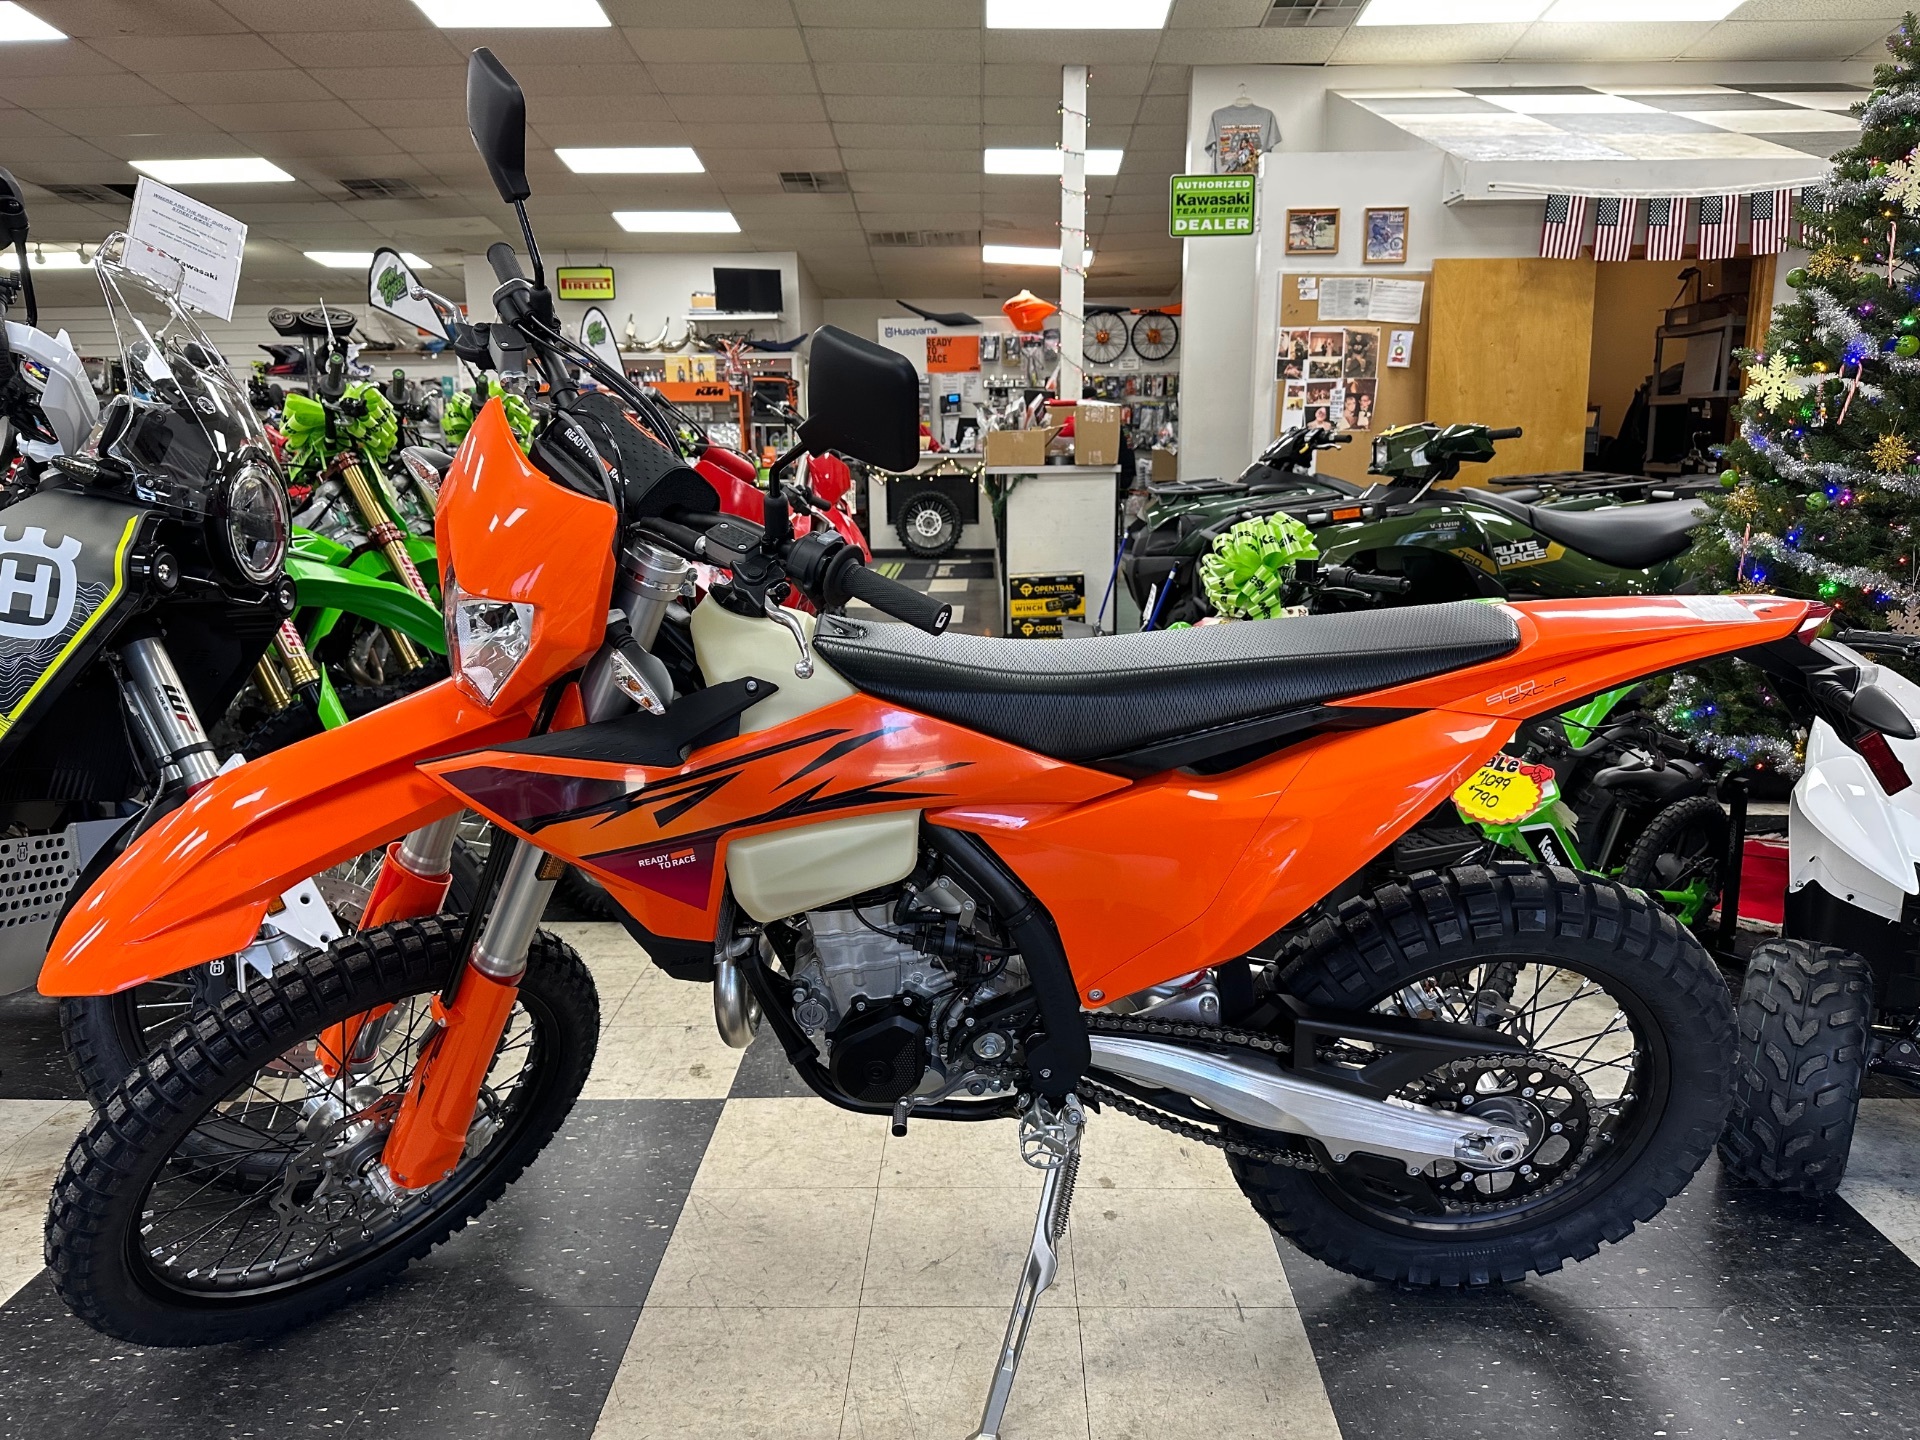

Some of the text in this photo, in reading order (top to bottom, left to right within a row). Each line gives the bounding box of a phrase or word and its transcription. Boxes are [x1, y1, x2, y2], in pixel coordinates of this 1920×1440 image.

[1176, 180, 1250, 190] AUTHORIZED
[1176, 192, 1250, 206] Kawasaki
[1176, 206, 1249, 215] TEAM GREEN
[1175, 218, 1249, 231] DEALER
[173, 257, 218, 281] Kawasaki
[561, 278, 611, 290] PIRELLI
[894, 327, 937, 337] Husqvarna
[926, 338, 952, 347] READY
[927, 355, 948, 364] RACE
[695, 386, 724, 396] KTM
[564, 427, 586, 451] READY
[1430, 520, 1460, 529] V-TWIN
[1458, 549, 1483, 566] 750
[1486, 680, 1536, 706] 500
[1508, 677, 1567, 704] EXC-F
[1468, 784, 1500, 808] $790
[638, 853, 669, 867] READY
[658, 854, 697, 870] TO RACE
